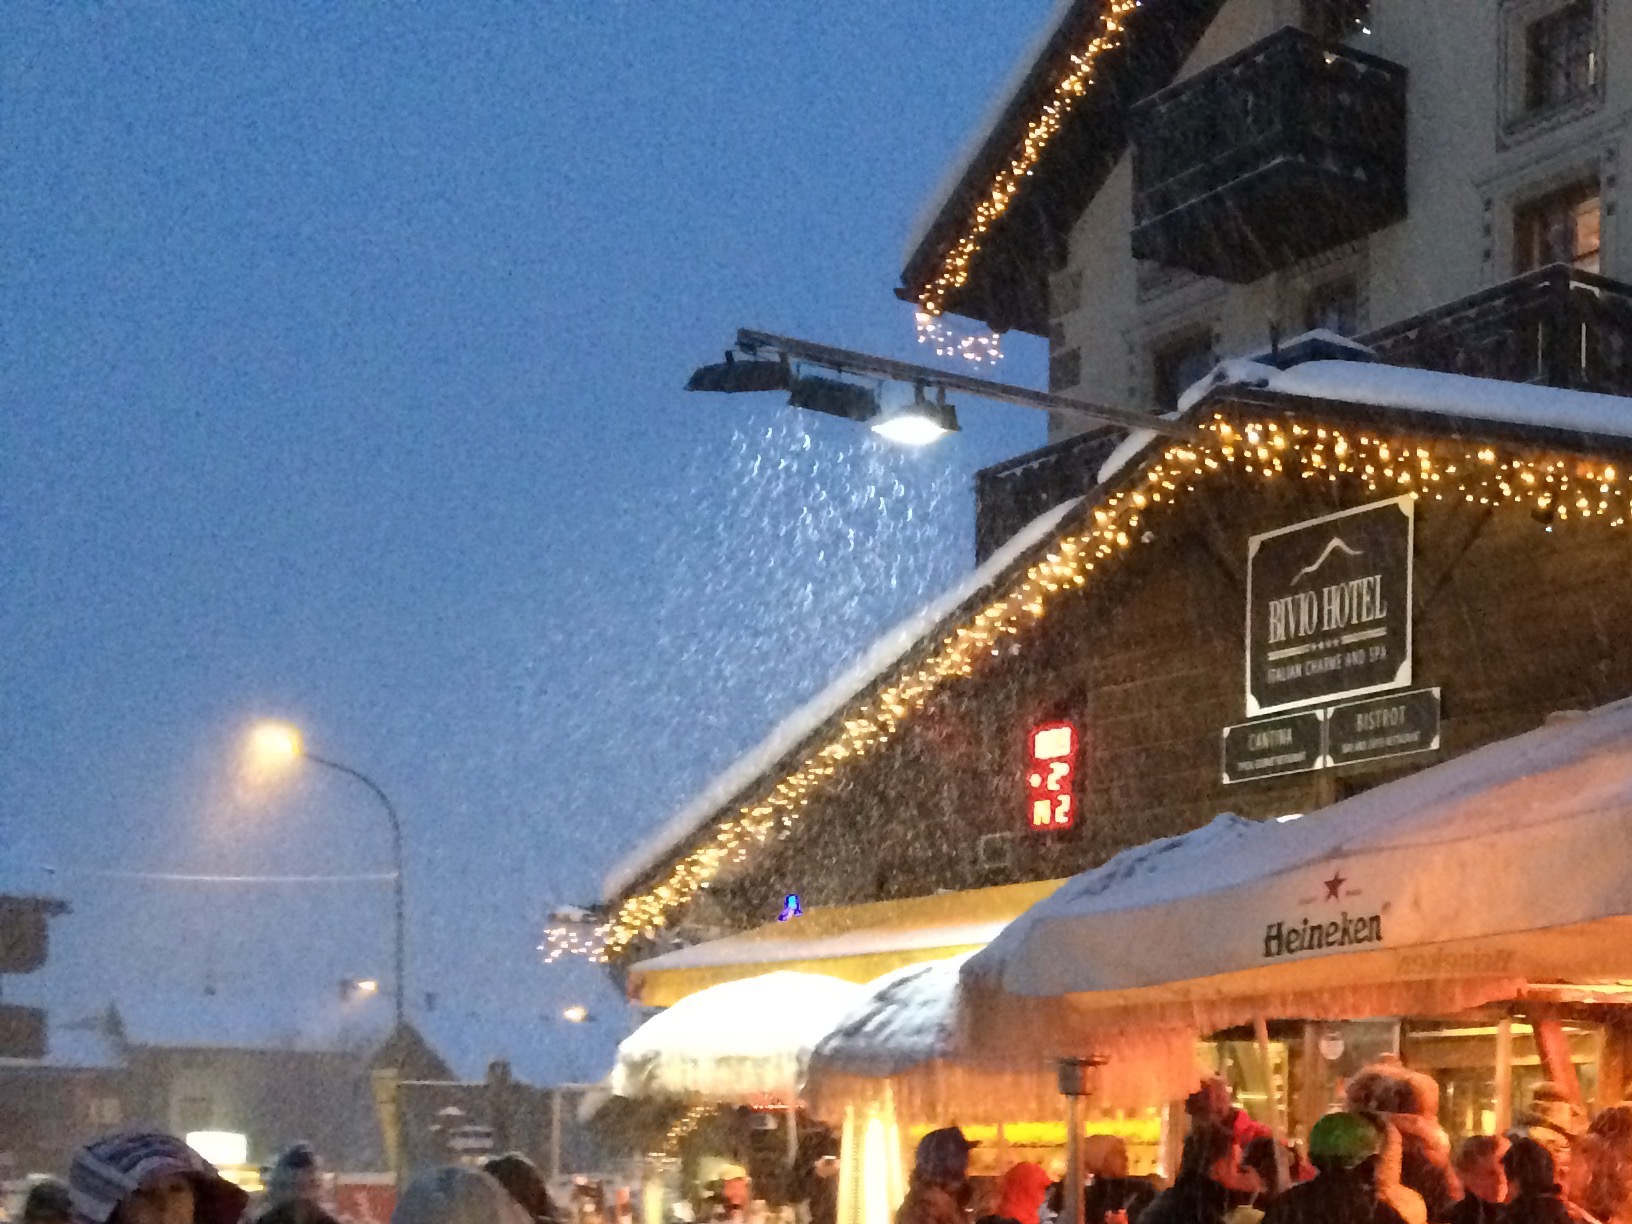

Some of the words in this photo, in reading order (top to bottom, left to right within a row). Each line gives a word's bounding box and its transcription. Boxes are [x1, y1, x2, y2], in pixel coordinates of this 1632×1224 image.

[1268, 590, 1318, 644] BIVIO
[1321, 574, 1388, 631] HOTEL
[1356, 705, 1406, 732] BISTROT
[1263, 911, 1383, 958] Heineken
